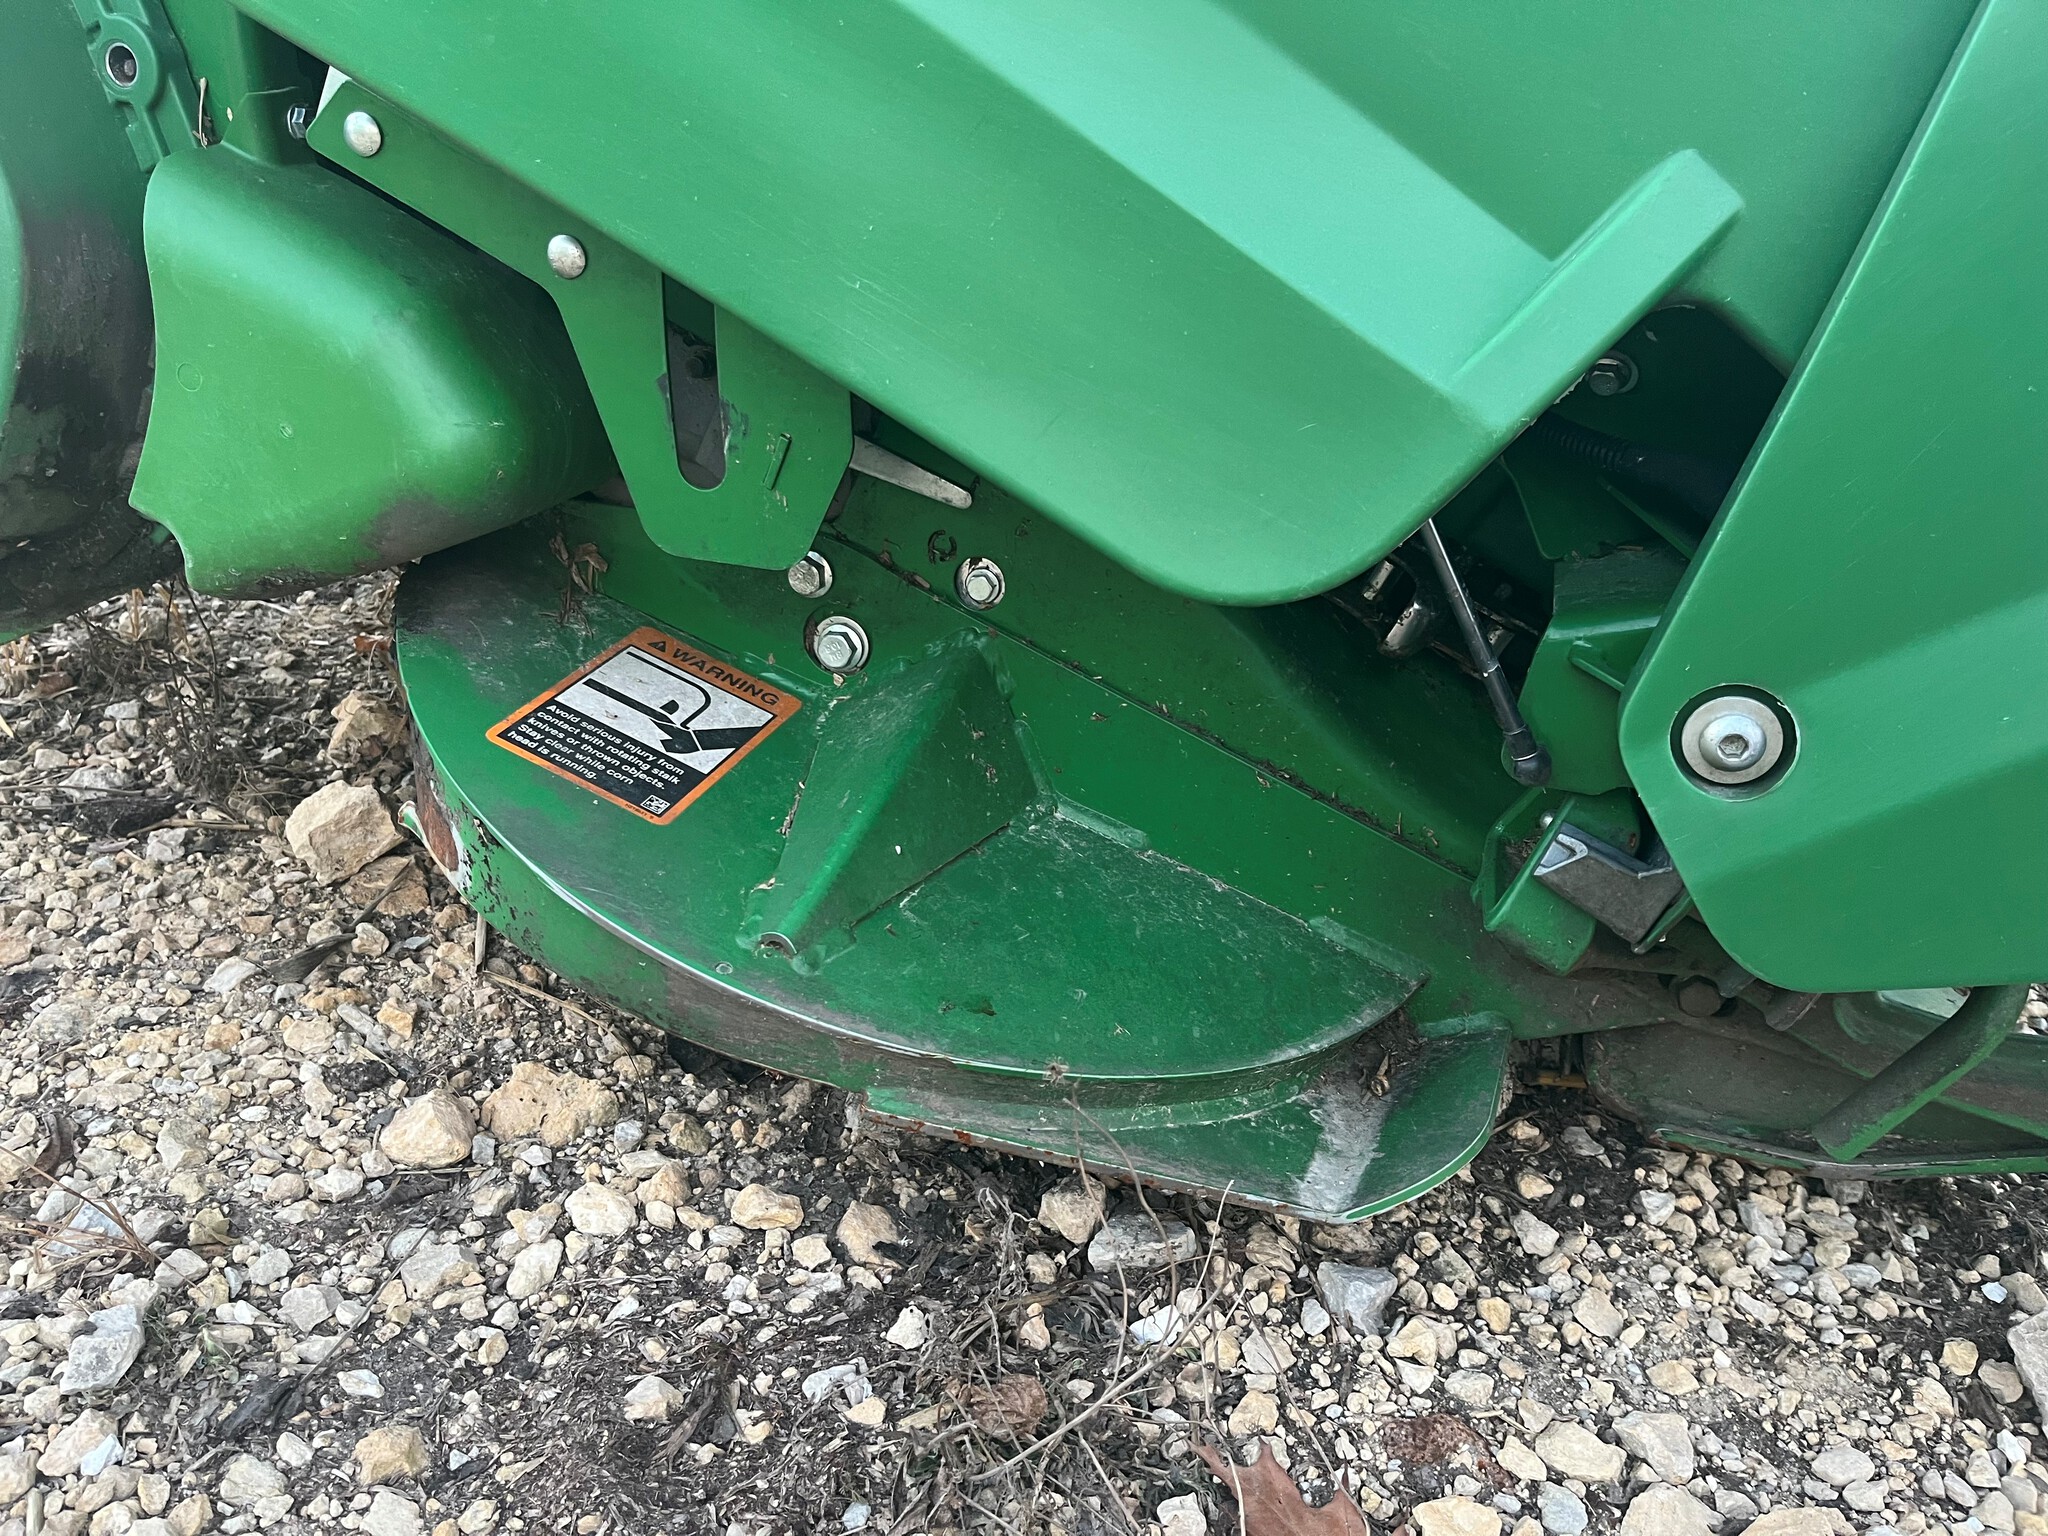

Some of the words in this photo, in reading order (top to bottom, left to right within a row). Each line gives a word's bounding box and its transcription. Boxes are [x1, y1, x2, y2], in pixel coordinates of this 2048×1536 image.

[672, 647, 781, 707] WARNING
[507, 730, 539, 749] head
[537, 745, 550, 755] is
[550, 753, 597, 780] running.
[518, 724, 545, 740] Stay
[544, 738, 575, 754] clear
[575, 752, 605, 771] while
[606, 769, 634, 785] corn
[527, 717, 565, 739] knives
[566, 737, 581, 746] or
[580, 743, 621, 766] thrown
[621, 765, 665, 790] objects.
[537, 712, 580, 735] contact
[581, 732, 605, 747] with
[606, 745, 651, 771] rotating
[651, 768, 680, 785] stalk
[546, 705, 581, 723] Avoid
[580, 721, 622, 744] serious
[623, 741, 657, 761] injury
[657, 759, 685, 775] from
